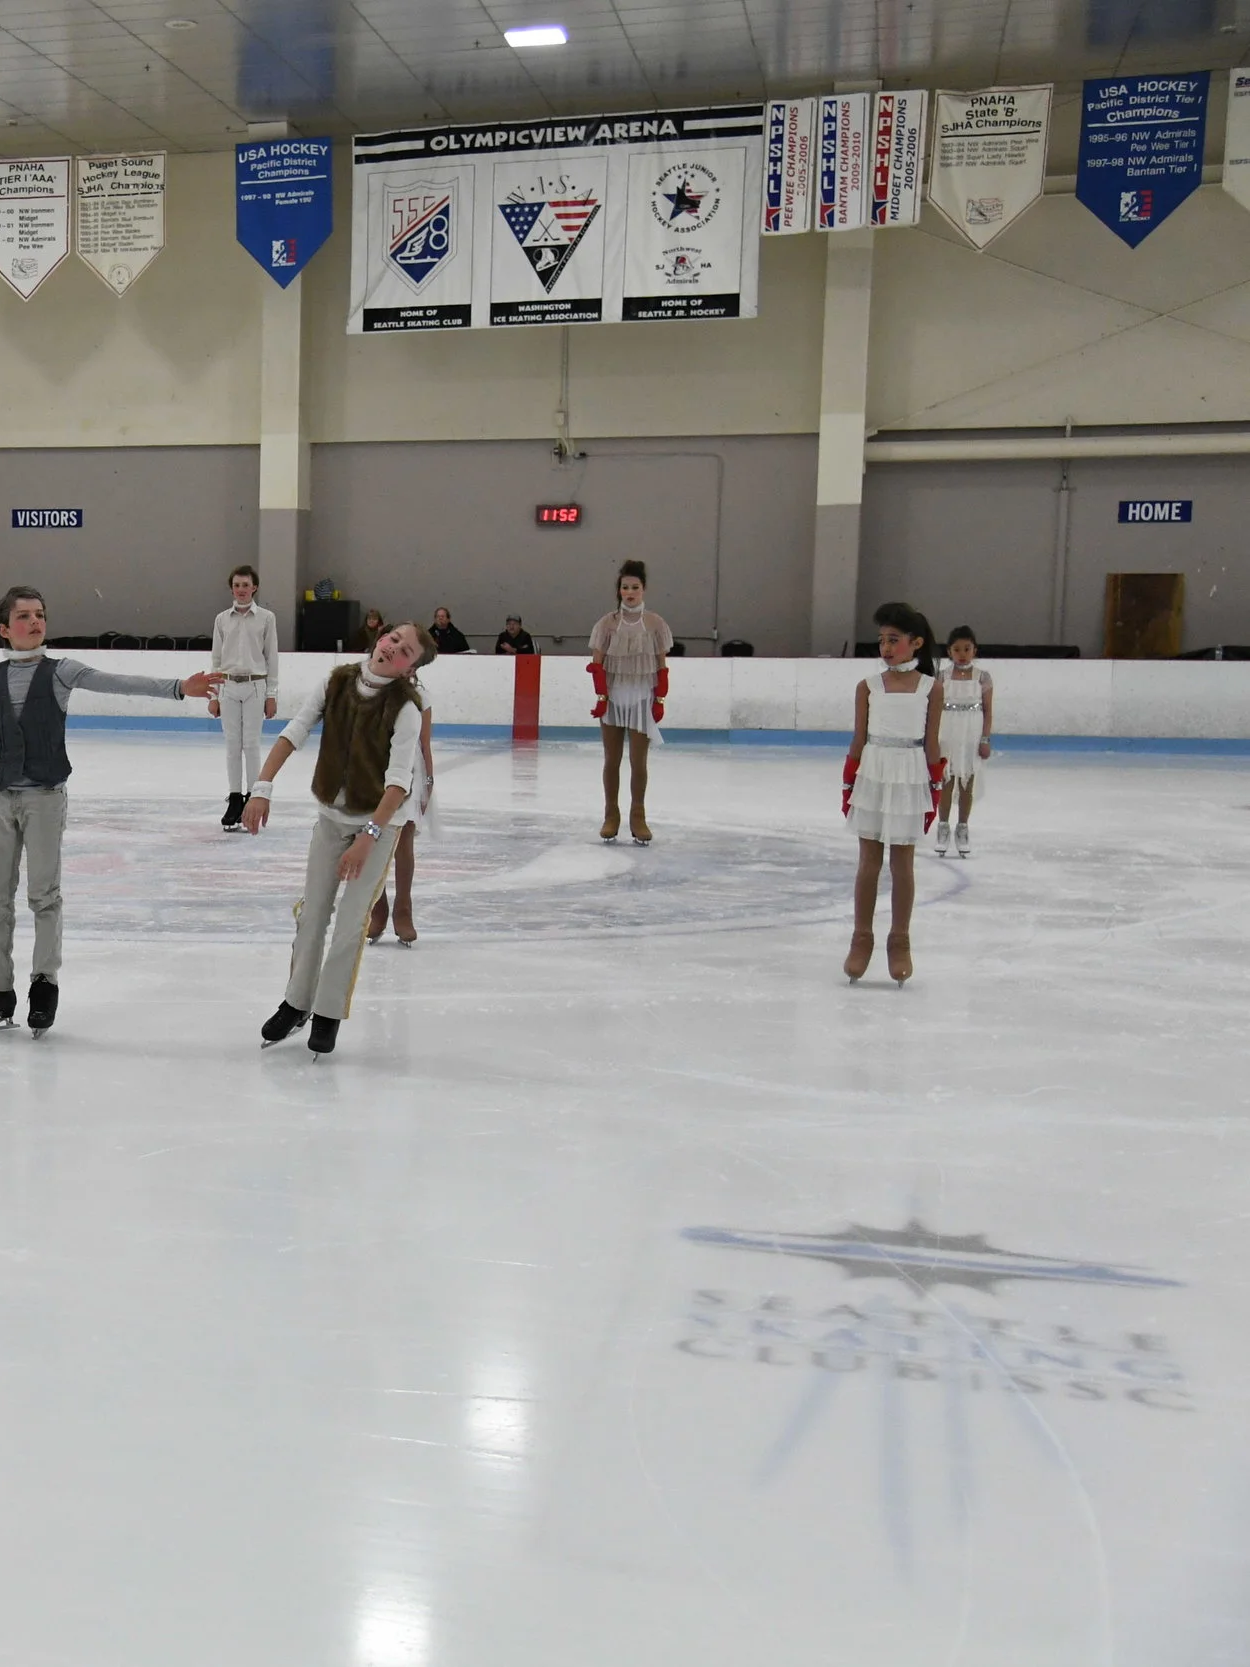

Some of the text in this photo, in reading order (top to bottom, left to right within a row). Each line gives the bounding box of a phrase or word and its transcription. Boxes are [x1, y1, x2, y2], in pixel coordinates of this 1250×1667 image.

[1099, 81, 1198, 98] USA HOCKEY
[971, 96, 1015, 107] PNAHA
[1087, 99, 1123, 111] Pacific
[1129, 94, 1169, 104] District
[1175, 94, 1194, 103] Tier
[966, 108, 998, 120] State
[1107, 106, 1180, 122] Champions
[942, 119, 1042, 133] SJHA Champions
[430, 119, 677, 151] OLYMPICVIEW ARENA
[1132, 132, 1150, 140] NW
[1155, 129, 1196, 140] Admirals
[823, 103, 836, 189] NPSHL
[876, 98, 893, 186] NPSHL
[1131, 144, 1146, 152] Pee
[1151, 142, 1169, 150] Wee
[1175, 140, 1189, 148] Tier
[239, 144, 328, 163] USA HOCKEY
[769, 107, 784, 194] NPSHL
[89, 159, 153, 170] Puget Sound
[251, 158, 317, 171] Pacific District
[839, 101, 850, 224] BANTAM CHAMPIONS
[851, 132, 861, 191] 2009-2010
[890, 99, 907, 220] MIDGET CHAMPIONS
[904, 128, 917, 189] 2005-2006
[1128, 157, 1146, 165] NW
[1150, 154, 1193, 164] Admirals
[9, 164, 45, 172] PNAHA
[258, 168, 309, 179] Champions
[784, 107, 798, 227] PEEWEE CHAMPIONS
[1127, 166, 1165, 176] Bantam
[1169, 165, 1187, 173] Tier
[83, 169, 160, 184] Hockey League
[656, 163, 717, 186] SEATTLE JUNIOR
[0, 186, 54, 195] Champions
[77, 184, 104, 195] SJHA
[651, 198, 721, 233] HOCKEY ASSOCIATION
[662, 246, 702, 256] Northwest
[400, 310, 424, 318] HOME
[518, 303, 571, 312] WASHINGTON
[374, 321, 404, 329] SEATTLE
[407, 319, 440, 327] SKATING
[509, 314, 542, 322] SKATING
[545, 312, 598, 320] ASSOCIATION
[17, 511, 77, 526] VISITORS
[1128, 503, 1182, 520] HOME
